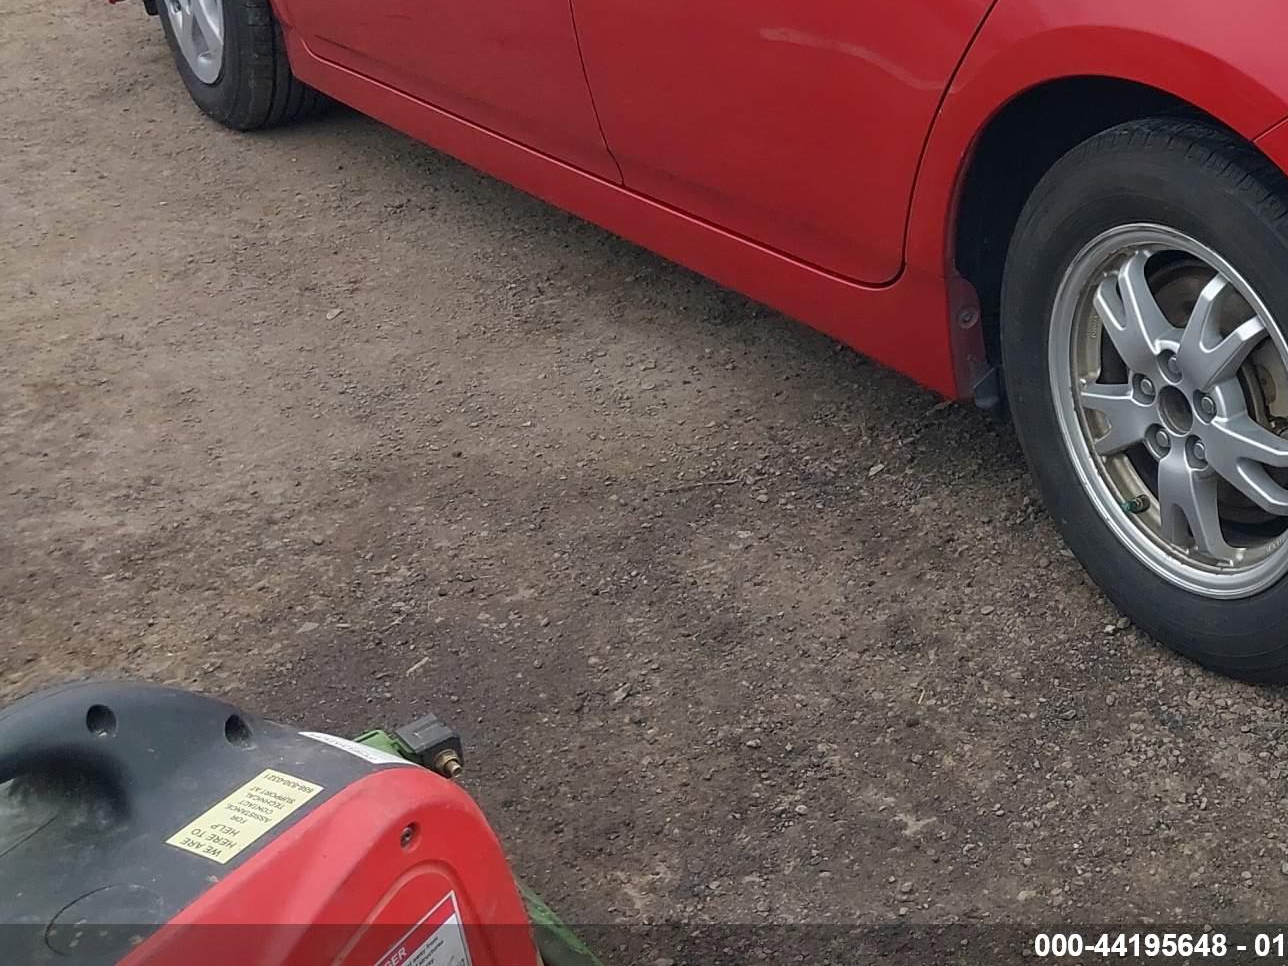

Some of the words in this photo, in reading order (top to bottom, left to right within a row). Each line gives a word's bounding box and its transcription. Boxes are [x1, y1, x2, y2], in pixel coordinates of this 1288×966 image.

[239, 799, 274, 815] CONTACT
[191, 828, 207, 838] TO
[210, 823, 240, 837] HELP
[180, 837, 206, 849] ARE
[205, 833, 237, 848] HERE
[202, 845, 222, 857] WE
